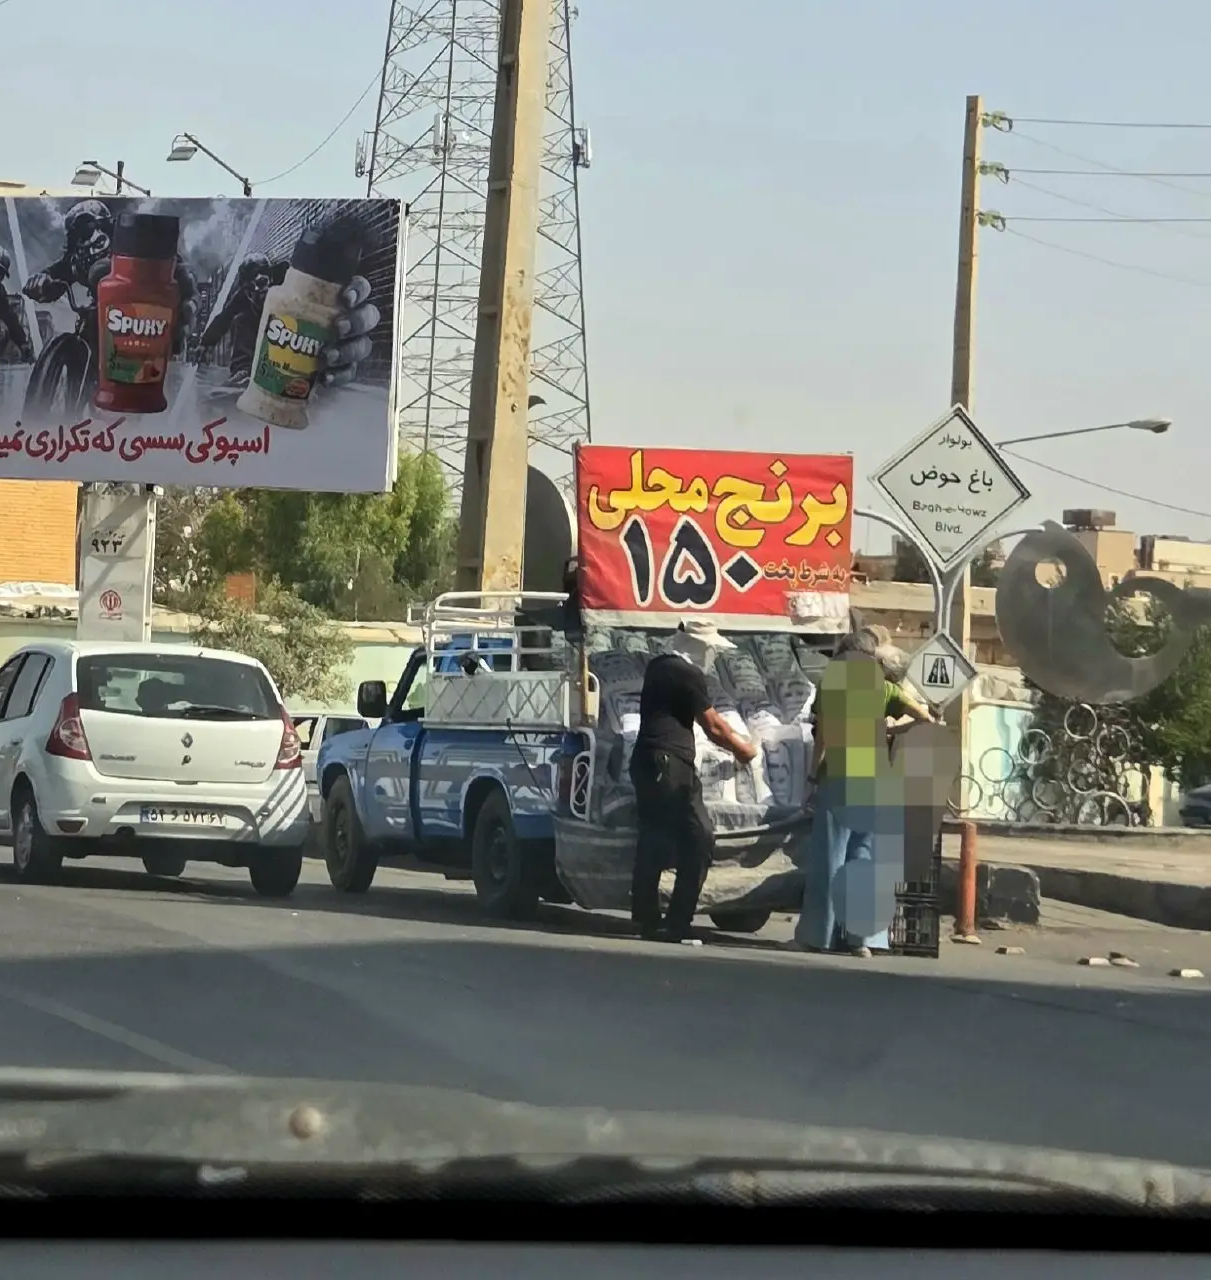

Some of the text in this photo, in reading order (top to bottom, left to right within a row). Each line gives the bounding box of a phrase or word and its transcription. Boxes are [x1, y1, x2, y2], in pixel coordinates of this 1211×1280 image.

[25, 419, 92, 463] تکراری
[92, 417, 127, 452] که
[119, 431, 185, 462] سسی
[186, 417, 270, 466] اسپوکی
[910, 465, 993, 494] باغ حوض
[588, 449, 848, 548] برنج محلی
[935, 521, 963, 534] Blvd.
[619, 514, 763, 608] ۱۵۰
[762, 558, 847, 590] به شرط پخت
